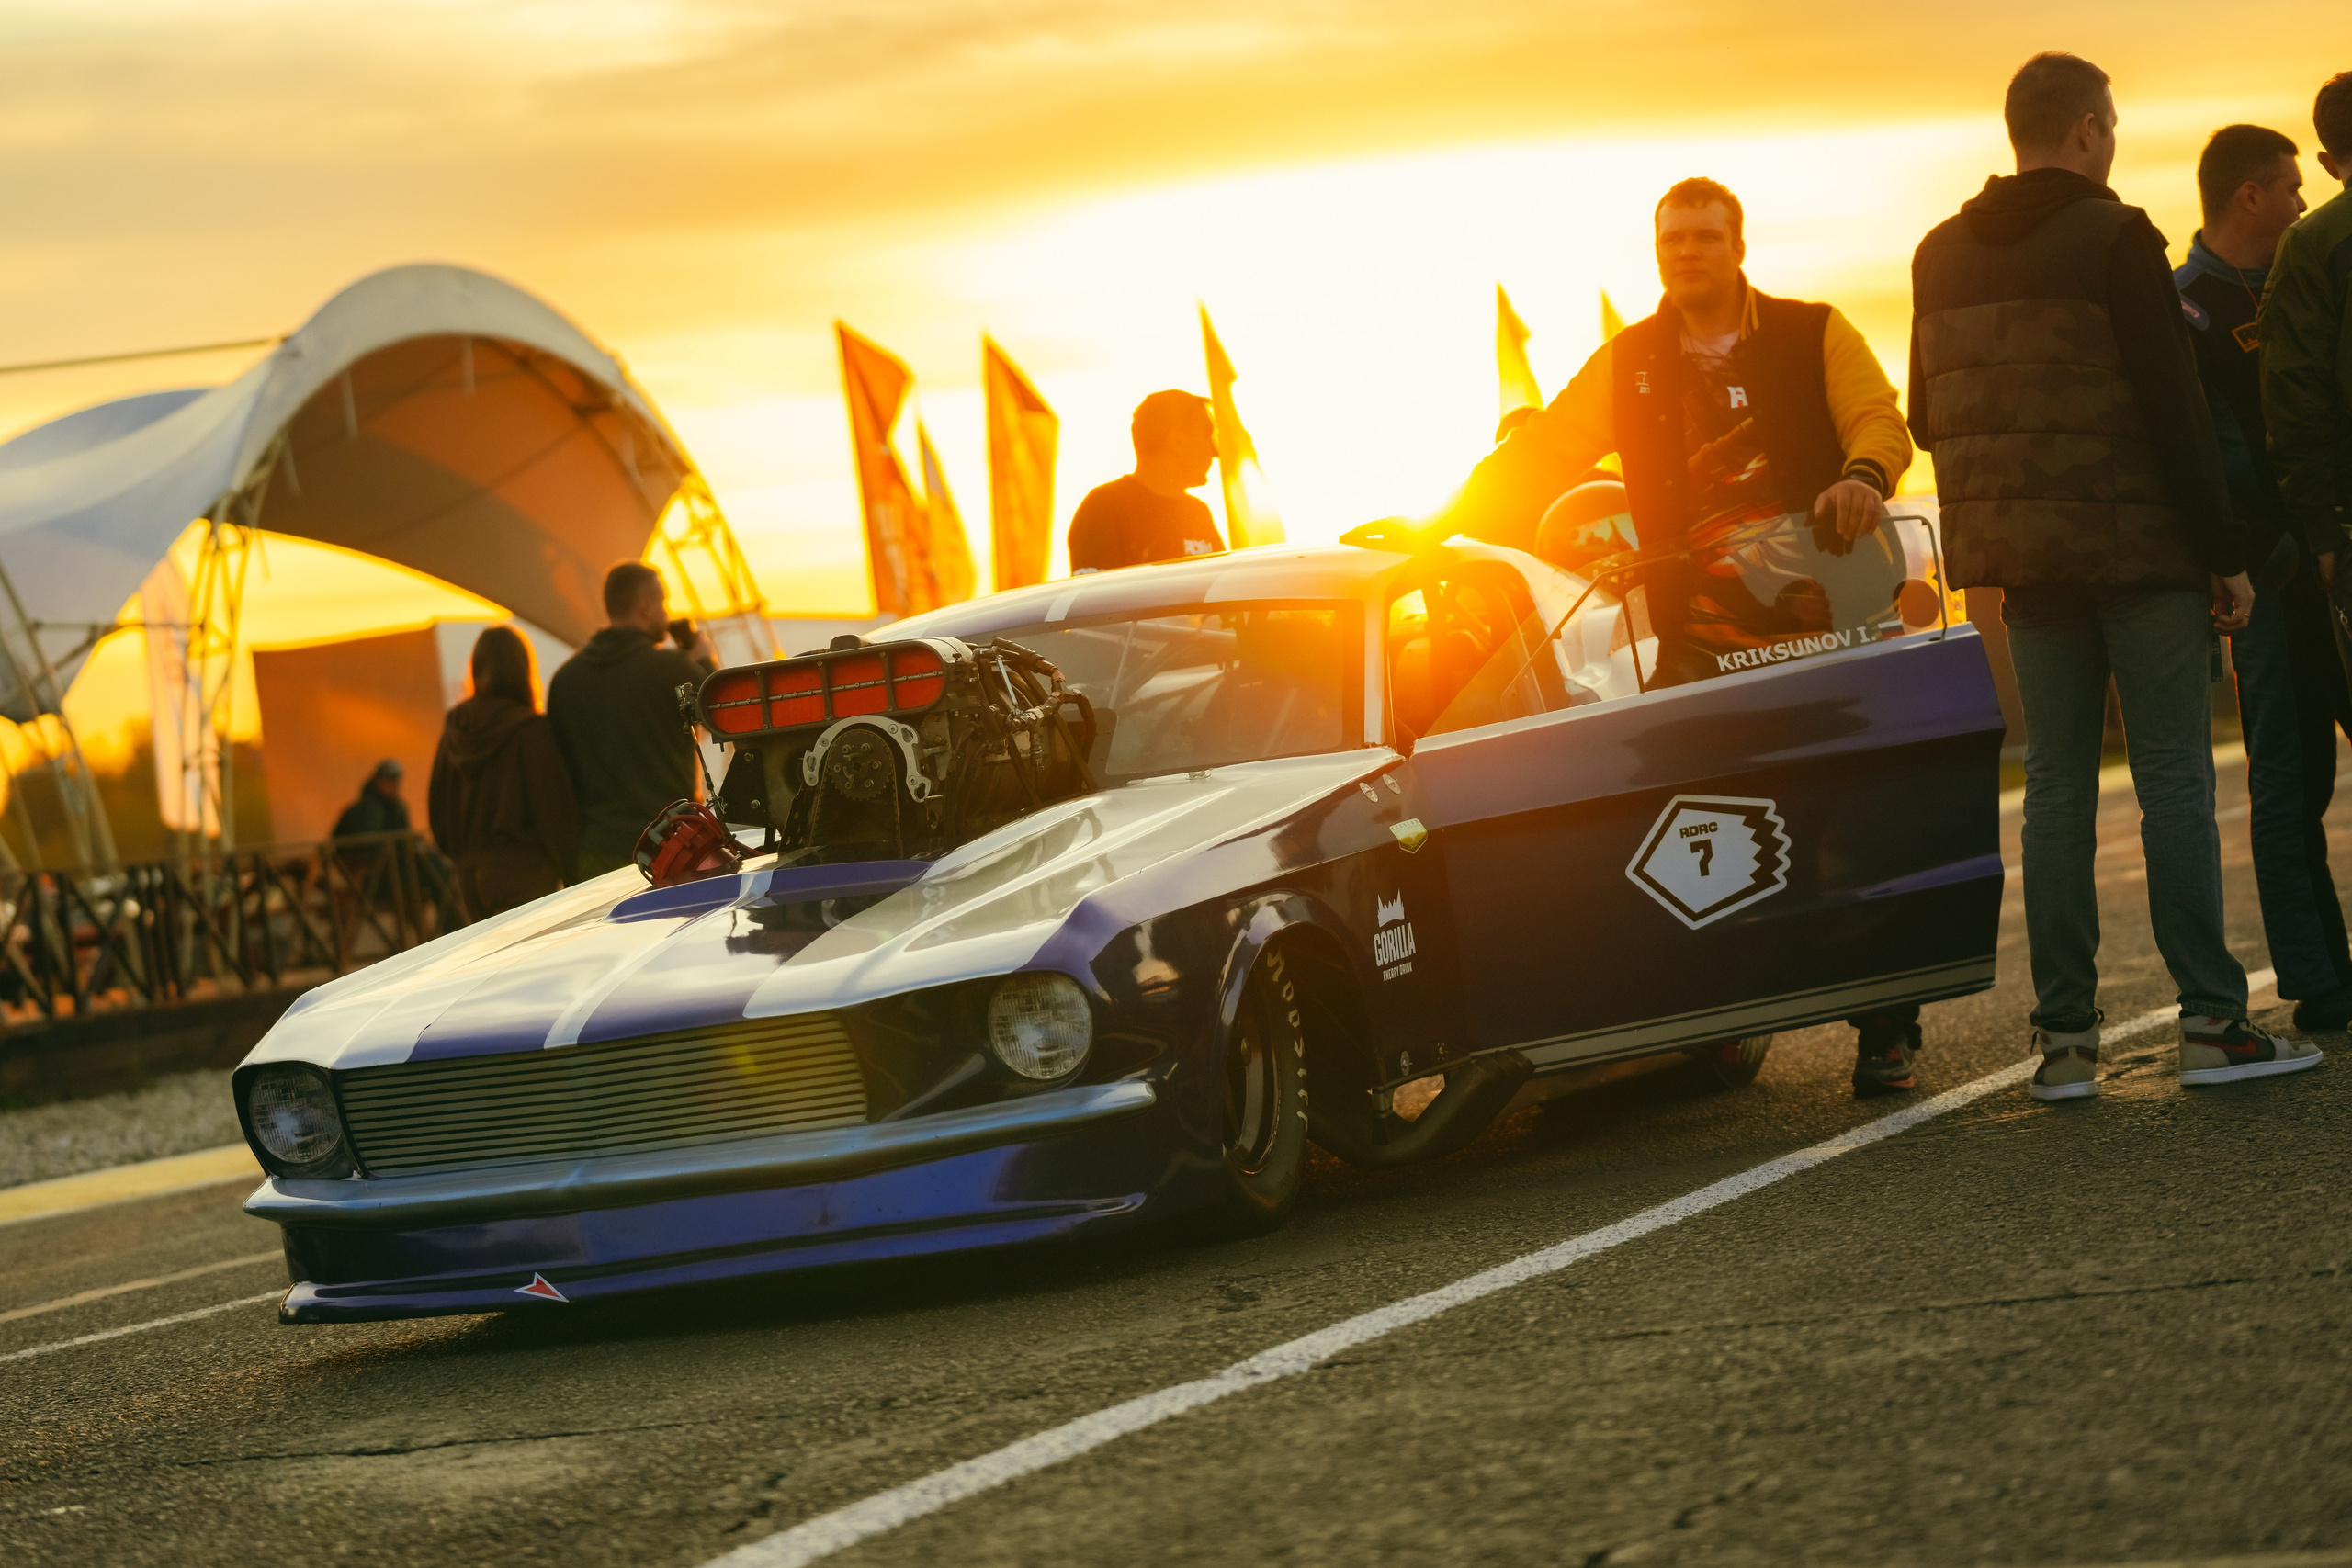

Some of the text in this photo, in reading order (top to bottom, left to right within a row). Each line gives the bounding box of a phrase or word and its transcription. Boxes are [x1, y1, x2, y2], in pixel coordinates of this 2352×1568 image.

[1716, 626, 1877, 671] KRIKSUNOV I.
[1679, 821, 1718, 839] RDRC
[1690, 838, 1713, 877] 7
[1374, 922, 1417, 966] GORILLA
[1383, 961, 1413, 982] ENERGY DRINK
